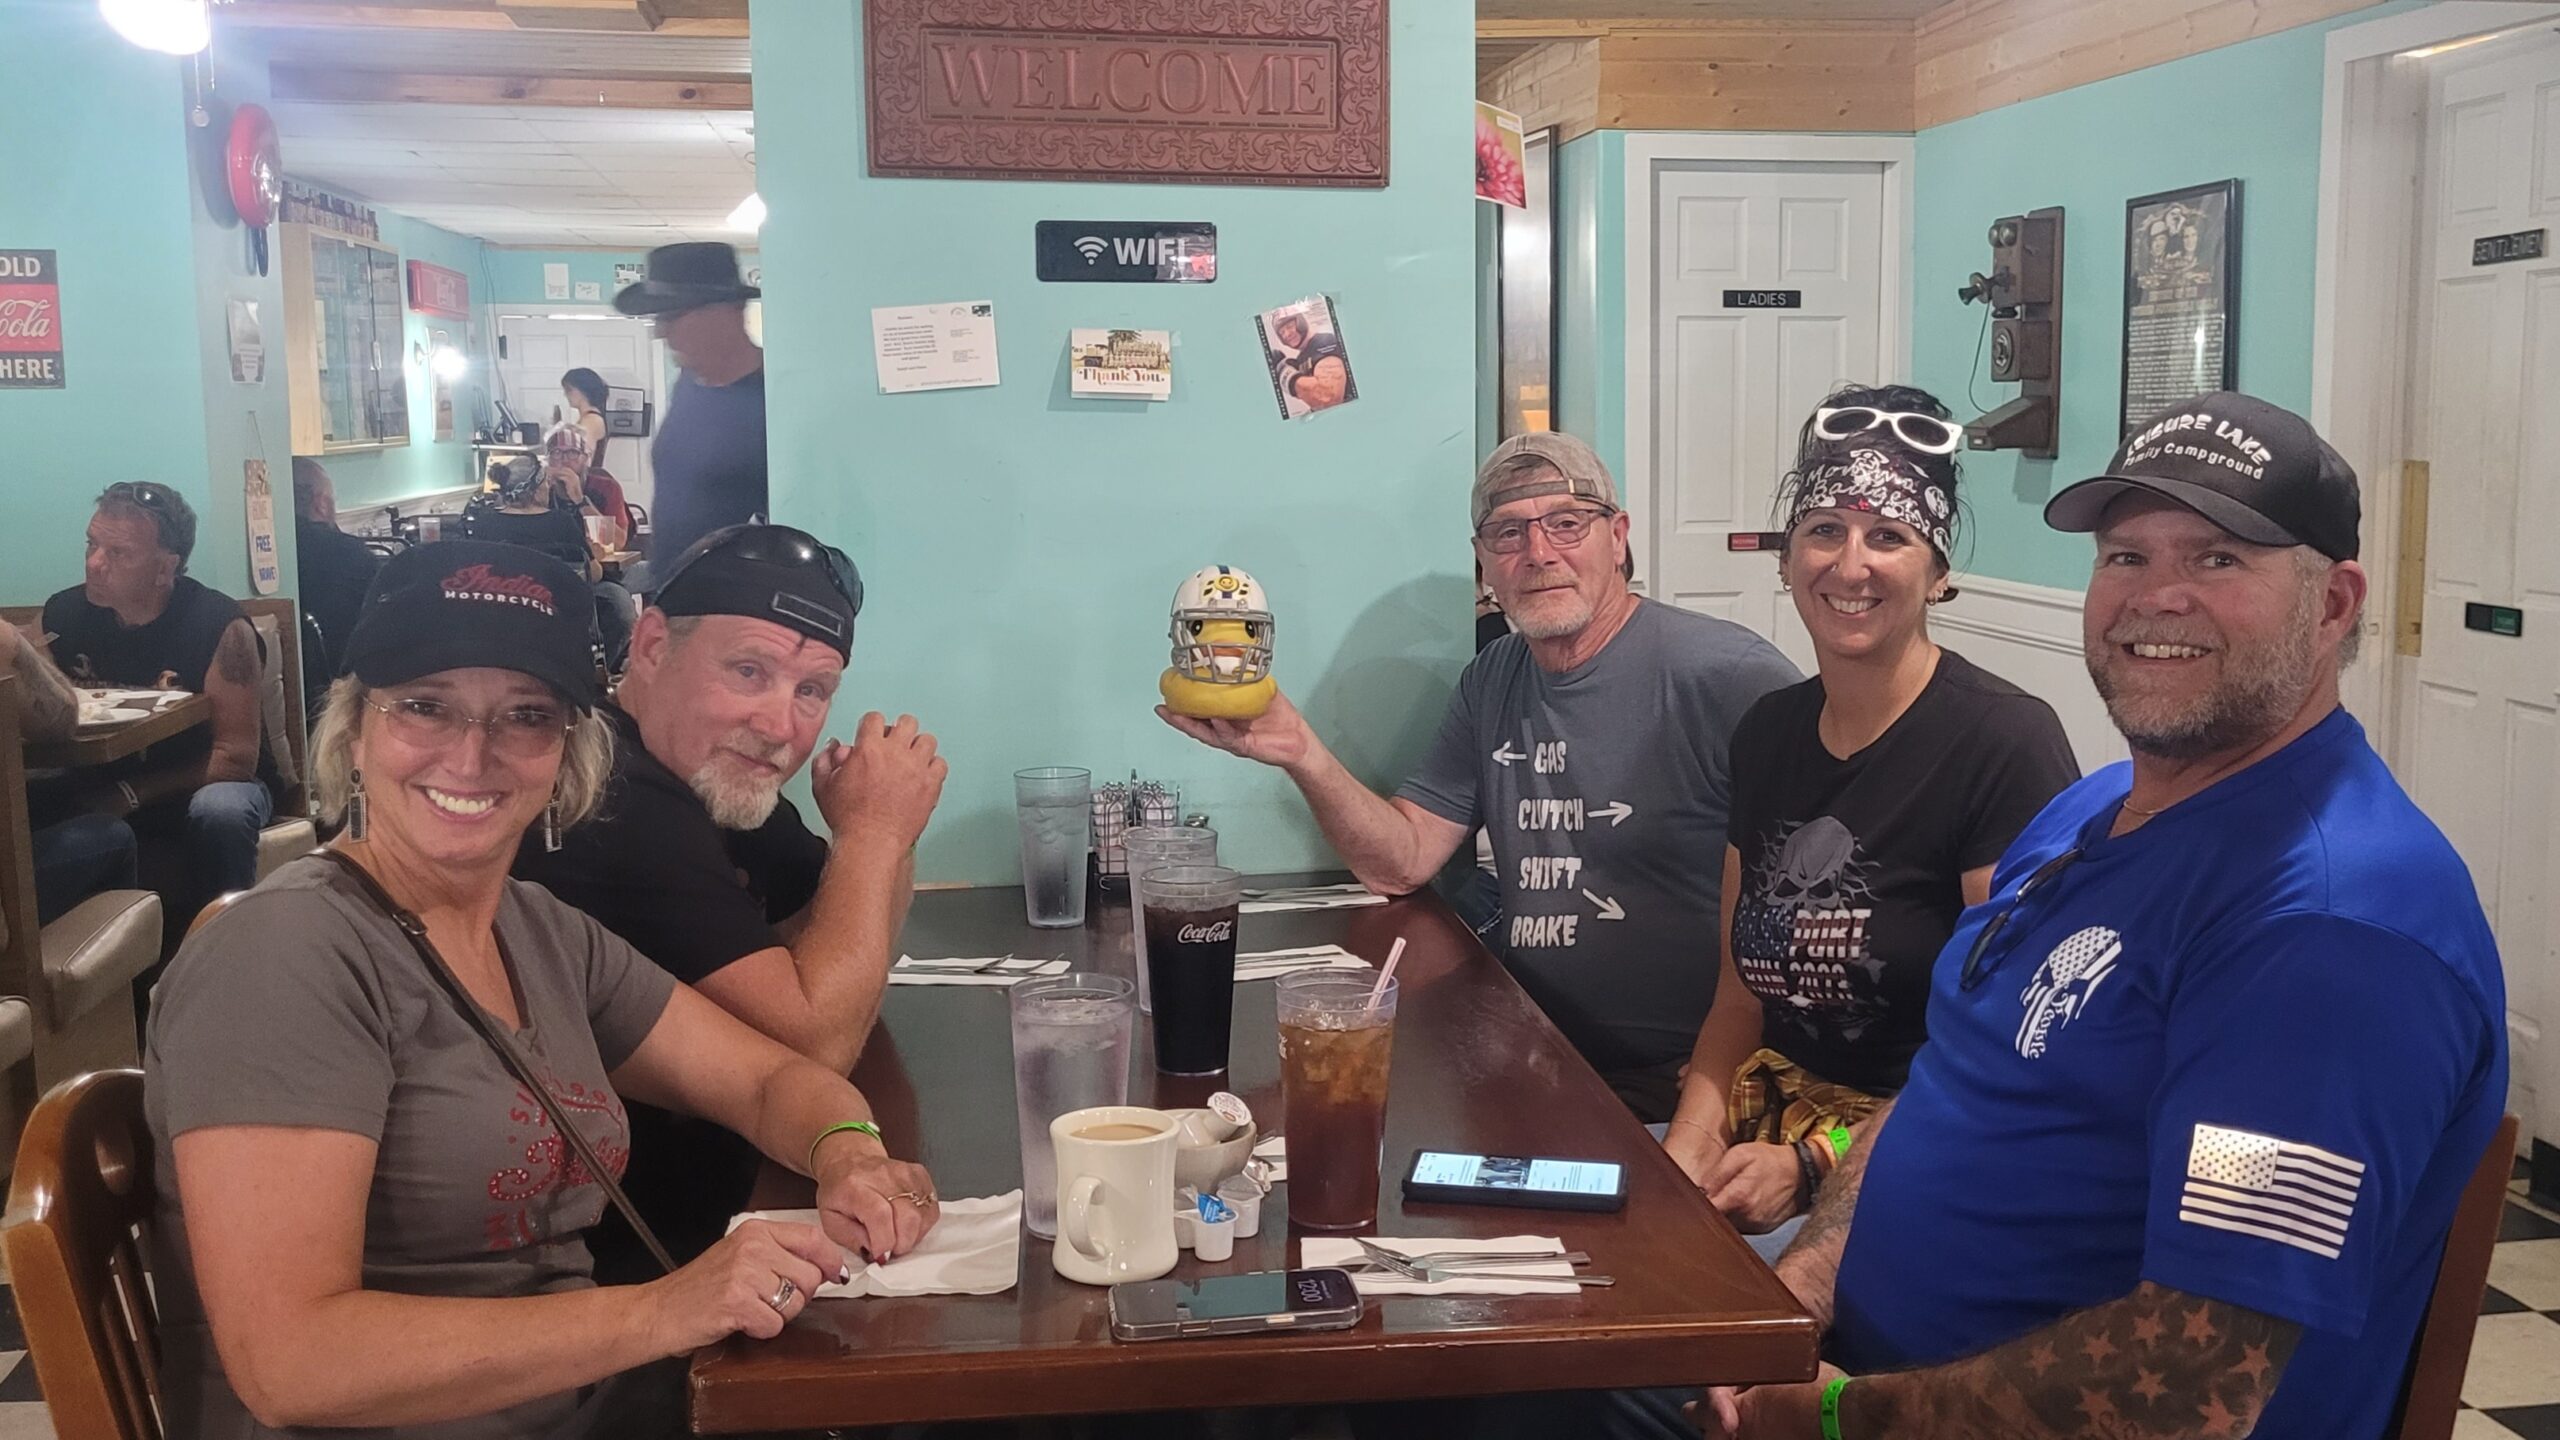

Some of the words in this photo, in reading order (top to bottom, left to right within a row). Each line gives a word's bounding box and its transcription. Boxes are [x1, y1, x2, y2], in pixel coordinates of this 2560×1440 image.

[931, 42, 1327, 116] WELCOME
[1113, 238, 1185, 266] WIFI
[1737, 293, 1786, 305] LADIES
[0, 358, 54, 379] HERE
[2127, 414, 2212, 457] LEISURE
[2215, 420, 2272, 466] LAKE
[2121, 446, 2161, 471] Family
[2164, 442, 2264, 480] Campground
[445, 590, 553, 616] MOTORCYCLE
[1534, 741, 1566, 774] GAS
[1518, 798, 1584, 831] CLUTCH
[1519, 857, 1582, 890] SHIFT
[1510, 914, 1579, 948] BRAKE
